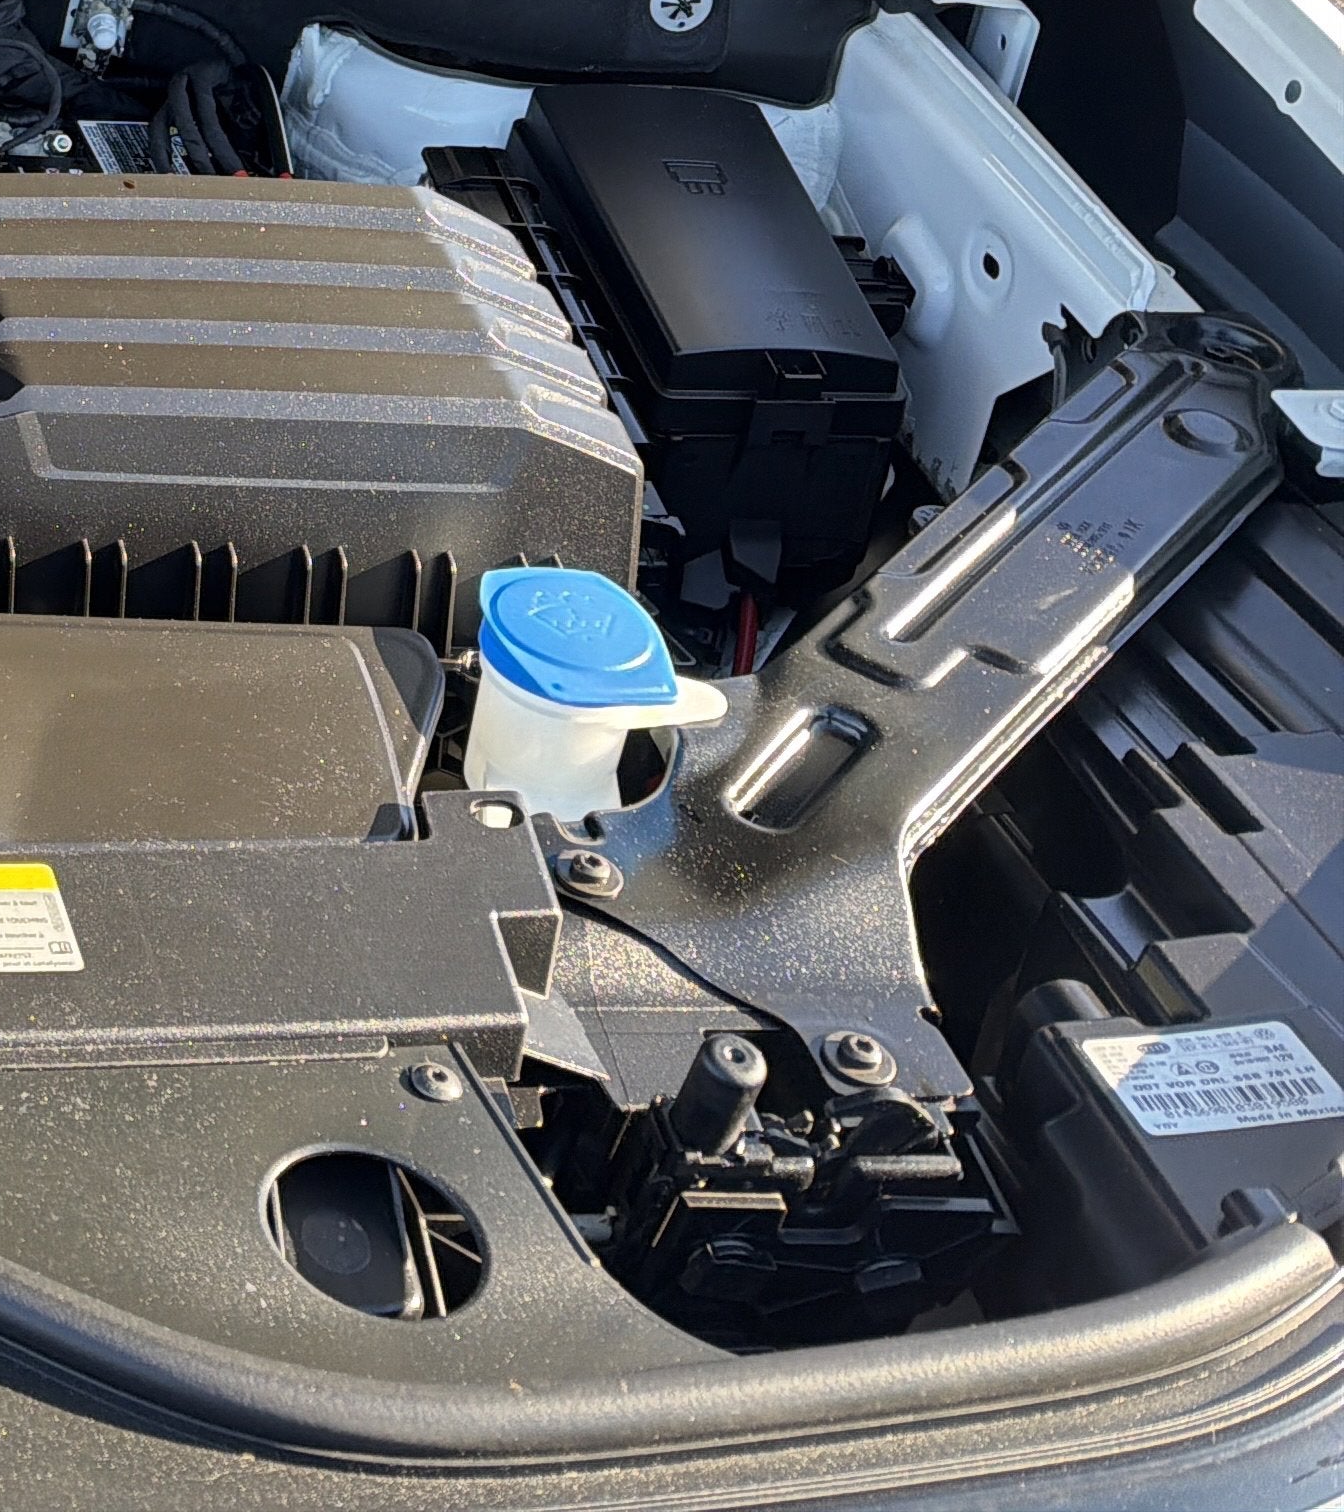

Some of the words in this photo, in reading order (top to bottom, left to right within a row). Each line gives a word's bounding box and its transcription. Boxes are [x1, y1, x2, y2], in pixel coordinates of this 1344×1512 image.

[1133, 1082, 1159, 1092] DOT
[1236, 1112, 1274, 1124] Made
[1278, 1111, 1292, 1119] in
